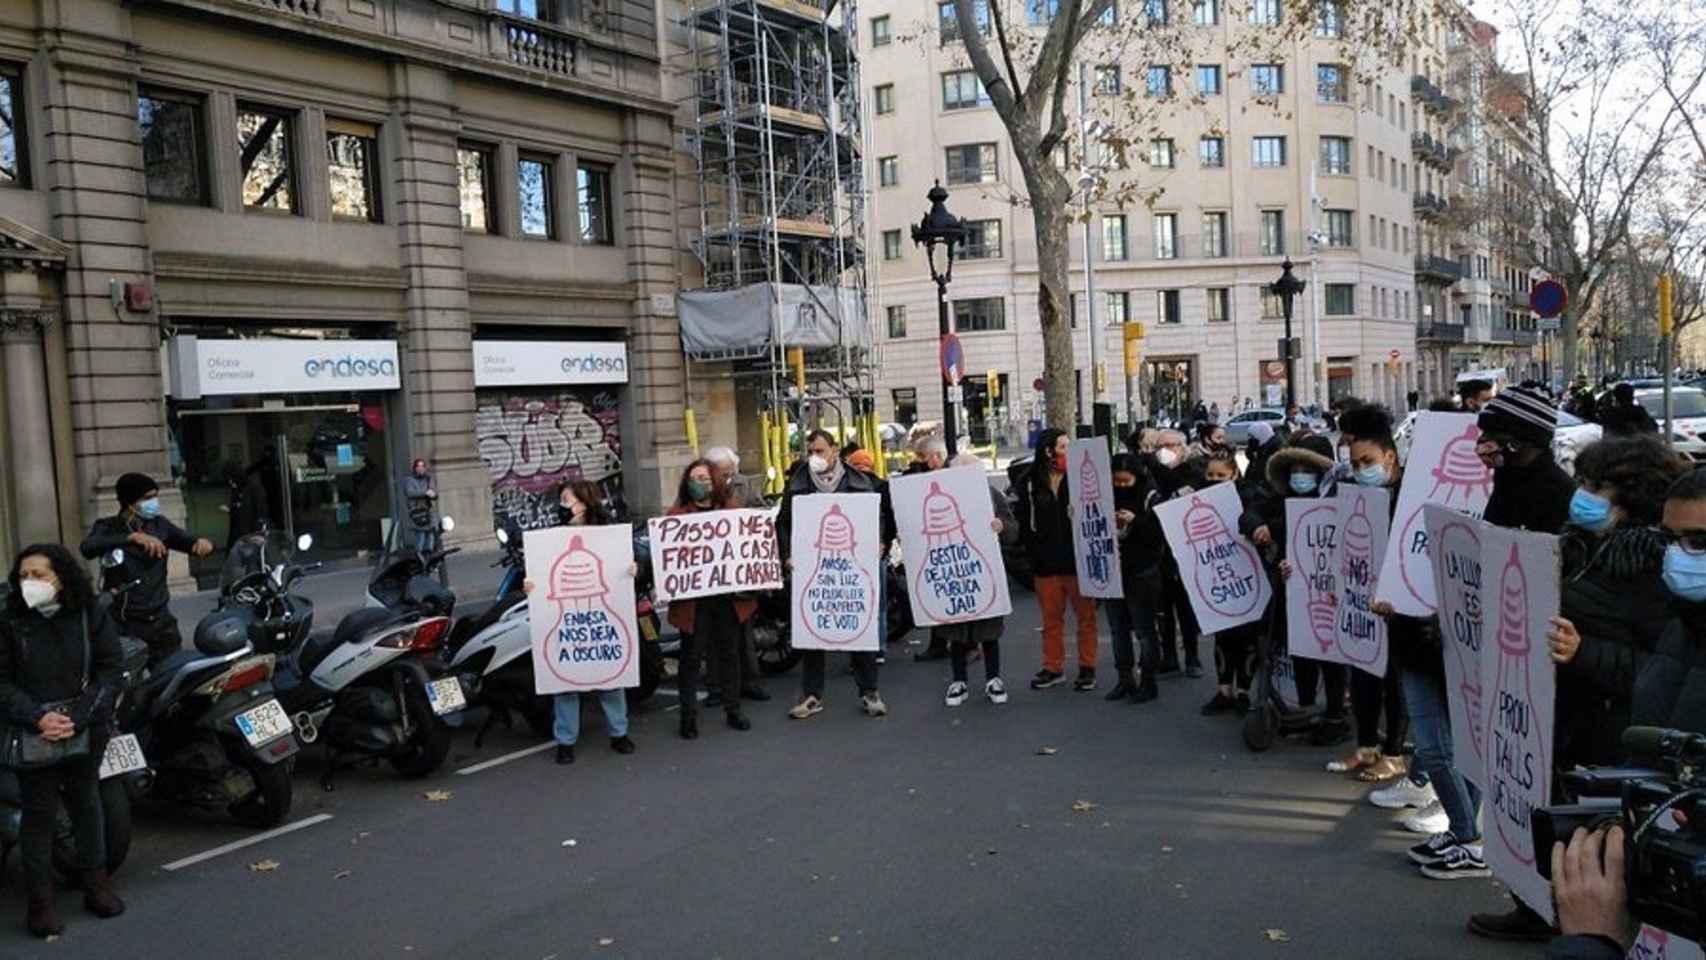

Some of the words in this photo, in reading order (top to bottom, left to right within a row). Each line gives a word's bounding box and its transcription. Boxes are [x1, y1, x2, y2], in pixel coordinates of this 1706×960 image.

[304, 354, 395, 378] endesa
[561, 352, 625, 373] endesa
[659, 518, 731, 542] PASSO
[739, 515, 776, 539] MES
[1307, 524, 1337, 549] LUZ
[662, 545, 715, 572] FRED
[721, 540, 735, 560] A
[740, 539, 779, 561] CASA
[1318, 552, 1326, 572] O
[664, 570, 703, 597] QUE
[708, 564, 731, 588] AL
[924, 566, 942, 585] DE
[1216, 562, 1234, 581] ES
[1349, 556, 1368, 586] NO
[1210, 574, 1253, 604] SALUT
[564, 610, 609, 627] ENDESA
[817, 613, 831, 630] DE
[833, 613, 859, 632] VOTO
[559, 626, 589, 643] NOS
[559, 647, 571, 662] A
[572, 643, 623, 663] OSCURAS
[1499, 691, 1530, 739] PROU
